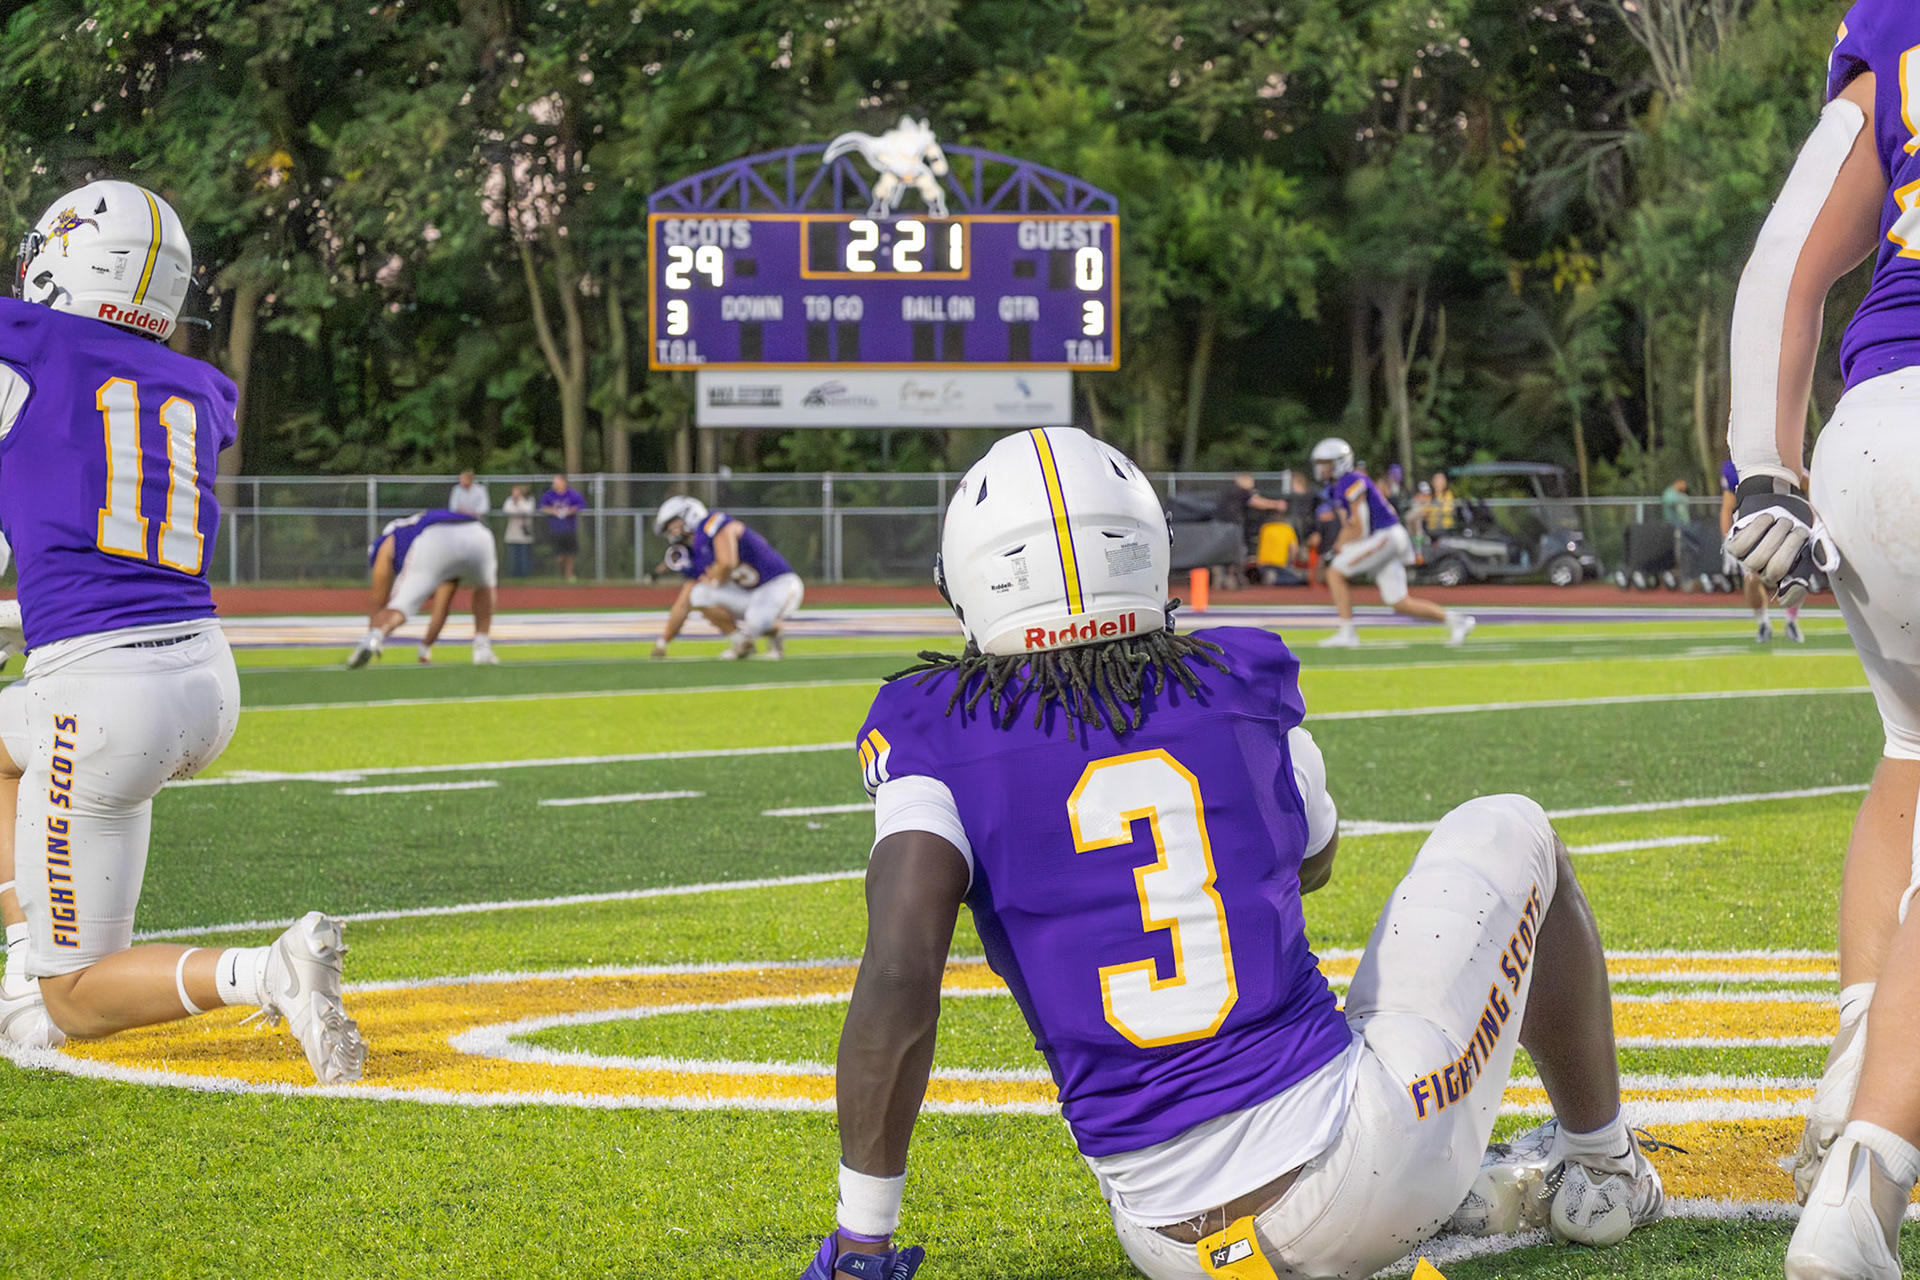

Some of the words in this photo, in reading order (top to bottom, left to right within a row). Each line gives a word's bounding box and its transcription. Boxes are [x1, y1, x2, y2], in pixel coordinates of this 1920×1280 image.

[663, 218, 752, 249] SCOTS
[846, 219, 963, 273] 2:21
[1017, 220, 1105, 249] GUEST
[665, 245, 724, 290] 29
[1075, 246, 1104, 291] 0
[98, 302, 170, 335] Riddell
[666, 299, 689, 336] 3
[721, 295, 784, 321] DOWN
[803, 295, 832, 321] TO
[833, 295, 864, 321] GO
[902, 295, 946, 321] BALL
[947, 295, 976, 321] ON
[998, 295, 1040, 322] QTR
[1082, 299, 1105, 336] 3
[96, 376, 204, 576] 11
[1025, 612, 1136, 651] Riddell
[49, 713, 78, 810] SCOTS
[46, 815, 80, 949] FIGHTING
[1066, 748, 1239, 1049] 3
[1409, 982, 1512, 1122] FIGHTING
